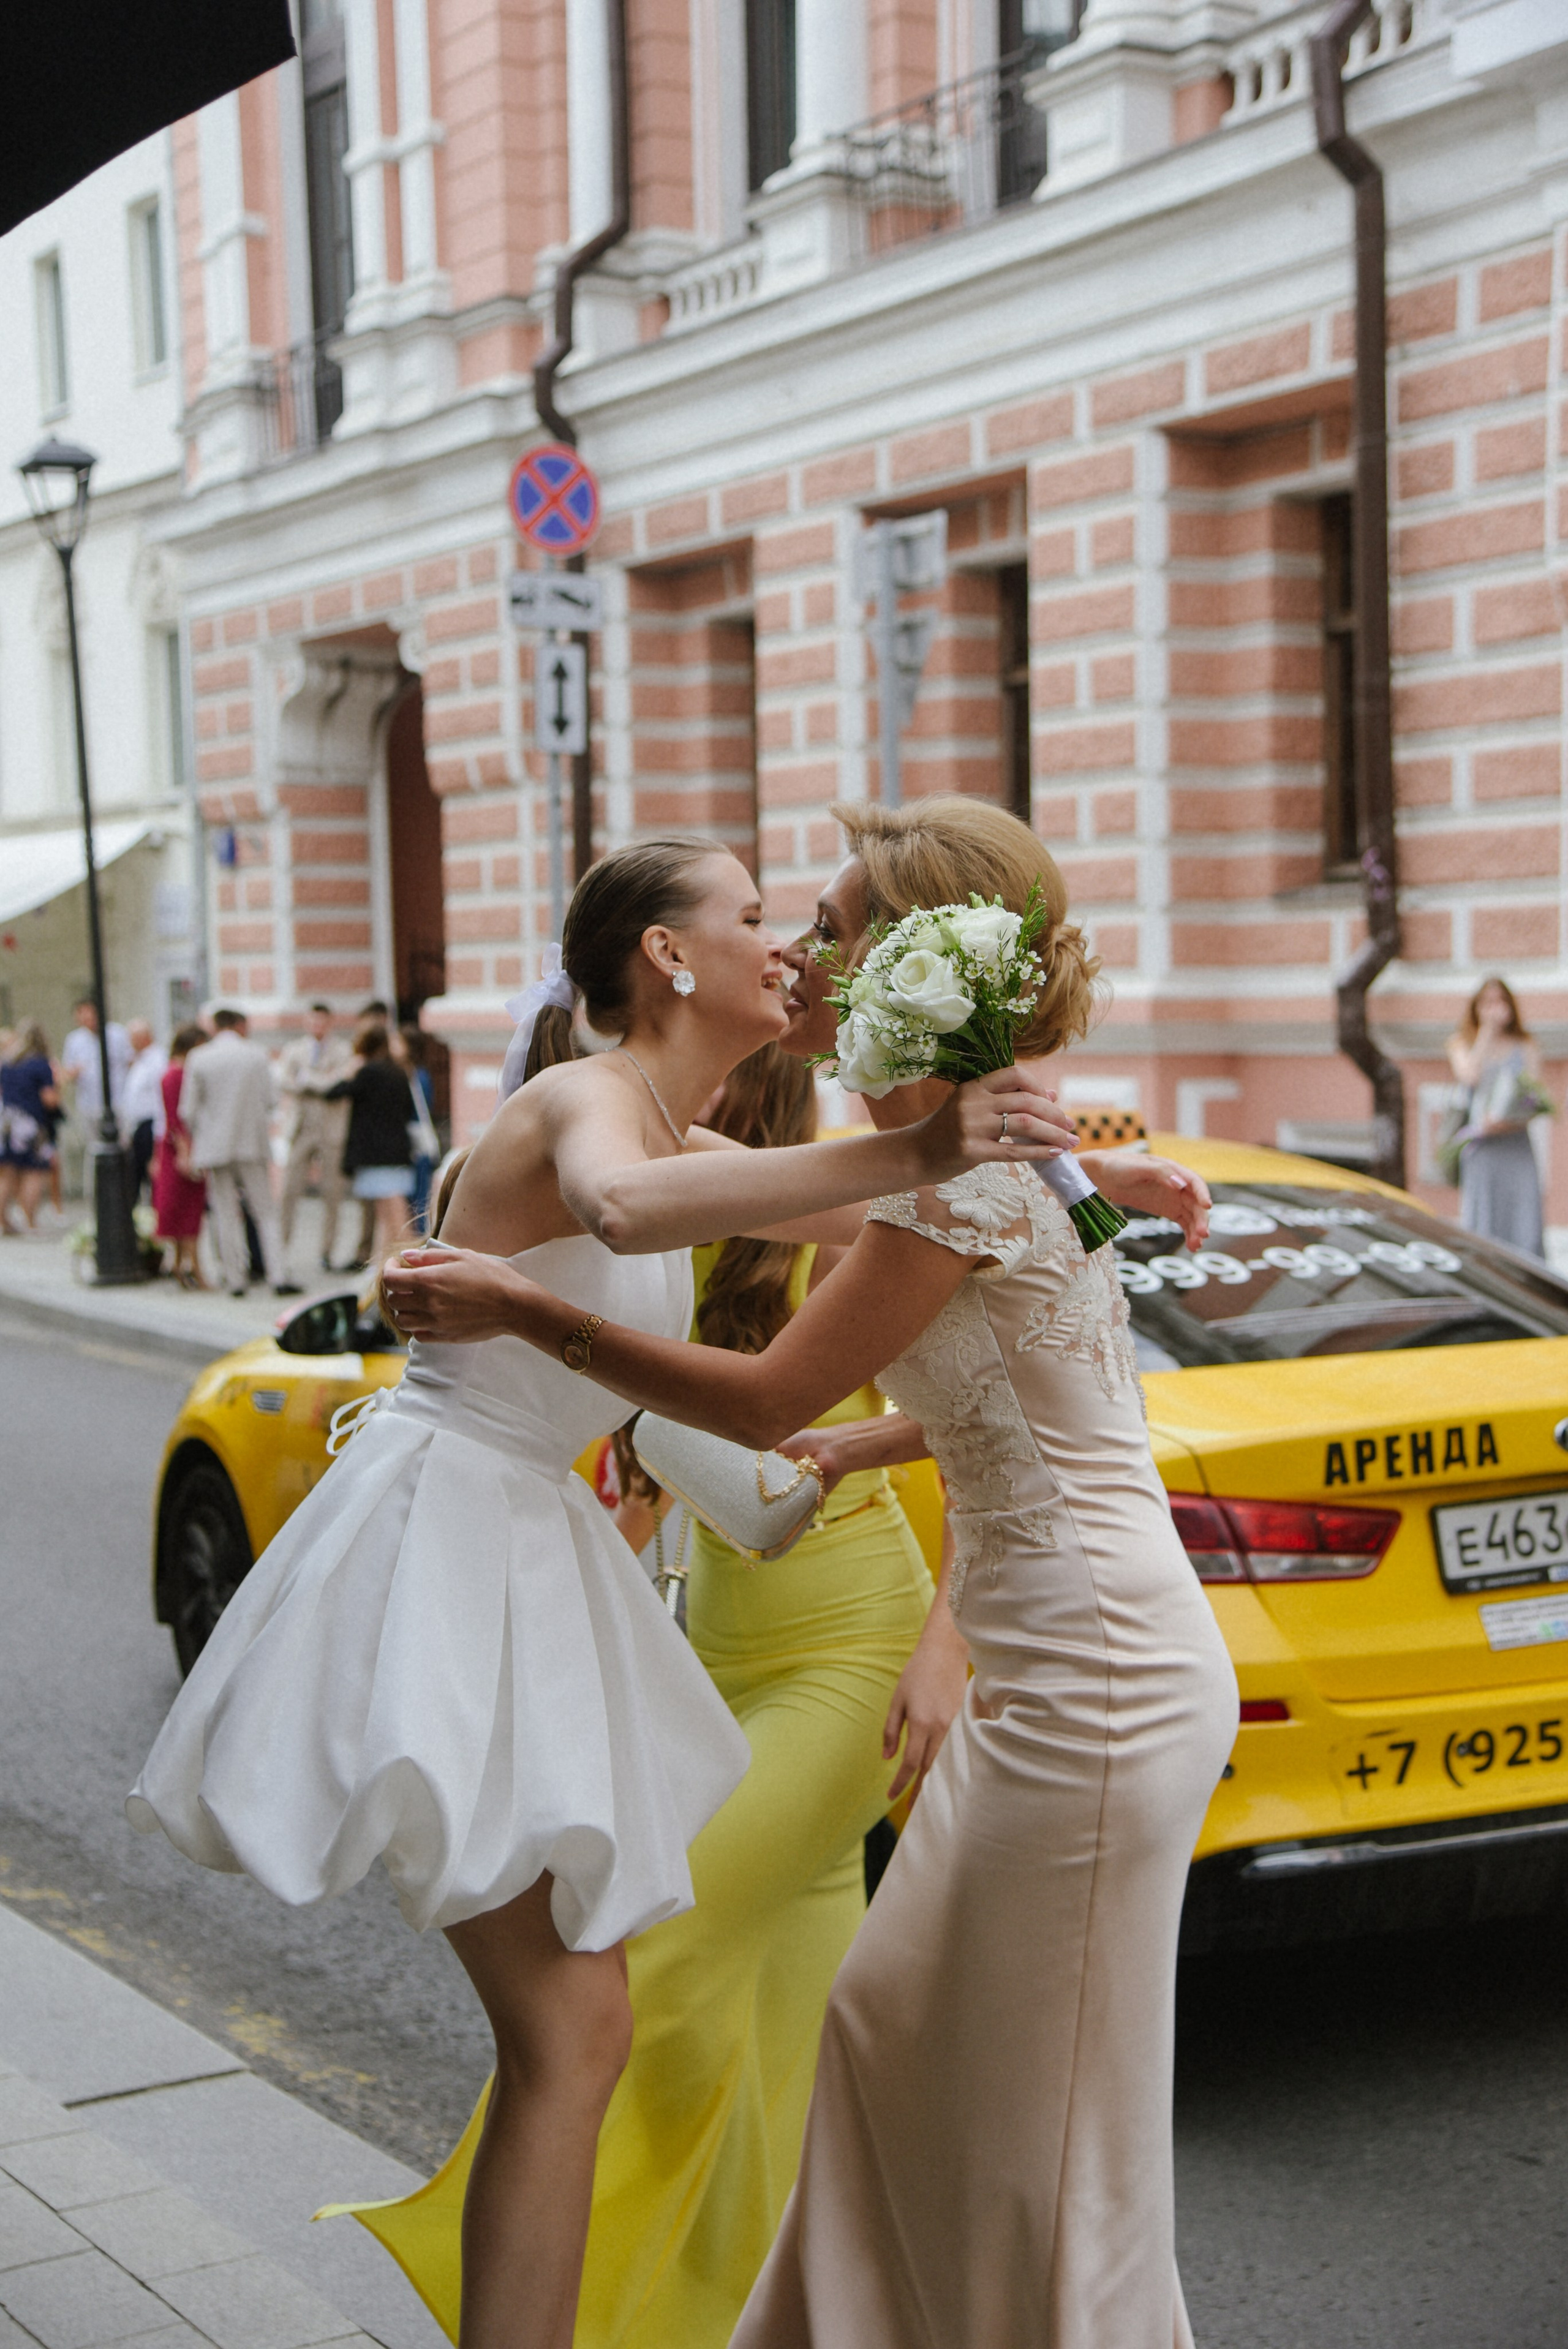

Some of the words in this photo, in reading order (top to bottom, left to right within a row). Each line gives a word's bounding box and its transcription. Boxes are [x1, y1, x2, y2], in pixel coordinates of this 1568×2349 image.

[1324, 1423, 1499, 1486] АРЕНДА
[1457, 1506, 1568, 1567] Е463
[1346, 1741, 1416, 1790] +7
[1444, 1719, 1562, 1788] (925
